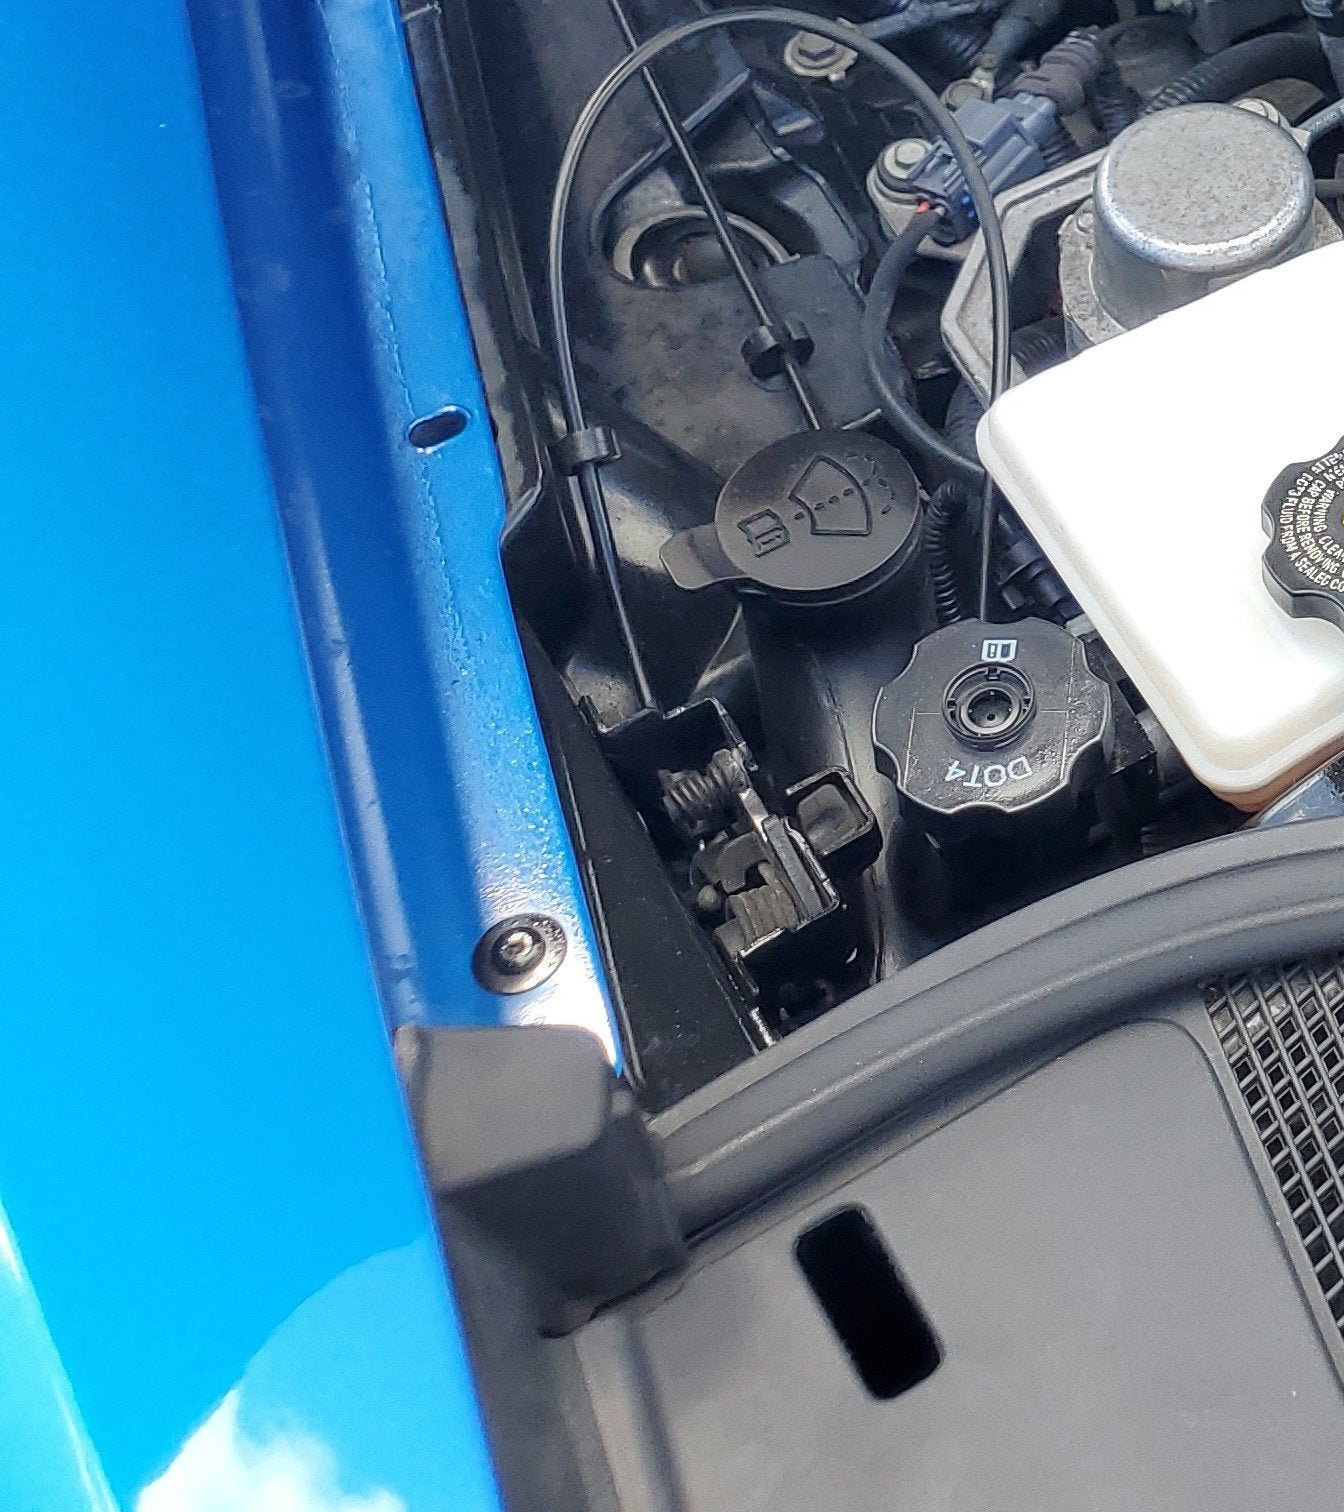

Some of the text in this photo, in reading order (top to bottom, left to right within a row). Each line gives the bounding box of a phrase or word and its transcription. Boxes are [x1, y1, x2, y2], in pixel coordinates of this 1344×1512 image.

[1306, 479, 1327, 498] CAP
[1279, 497, 1299, 524] FLUID
[1296, 496, 1316, 533] BEFORE
[1279, 524, 1299, 553] FROM
[1289, 551, 1302, 562] A
[1294, 557, 1332, 587] SEALED
[944, 755, 1034, 788] DOT4
